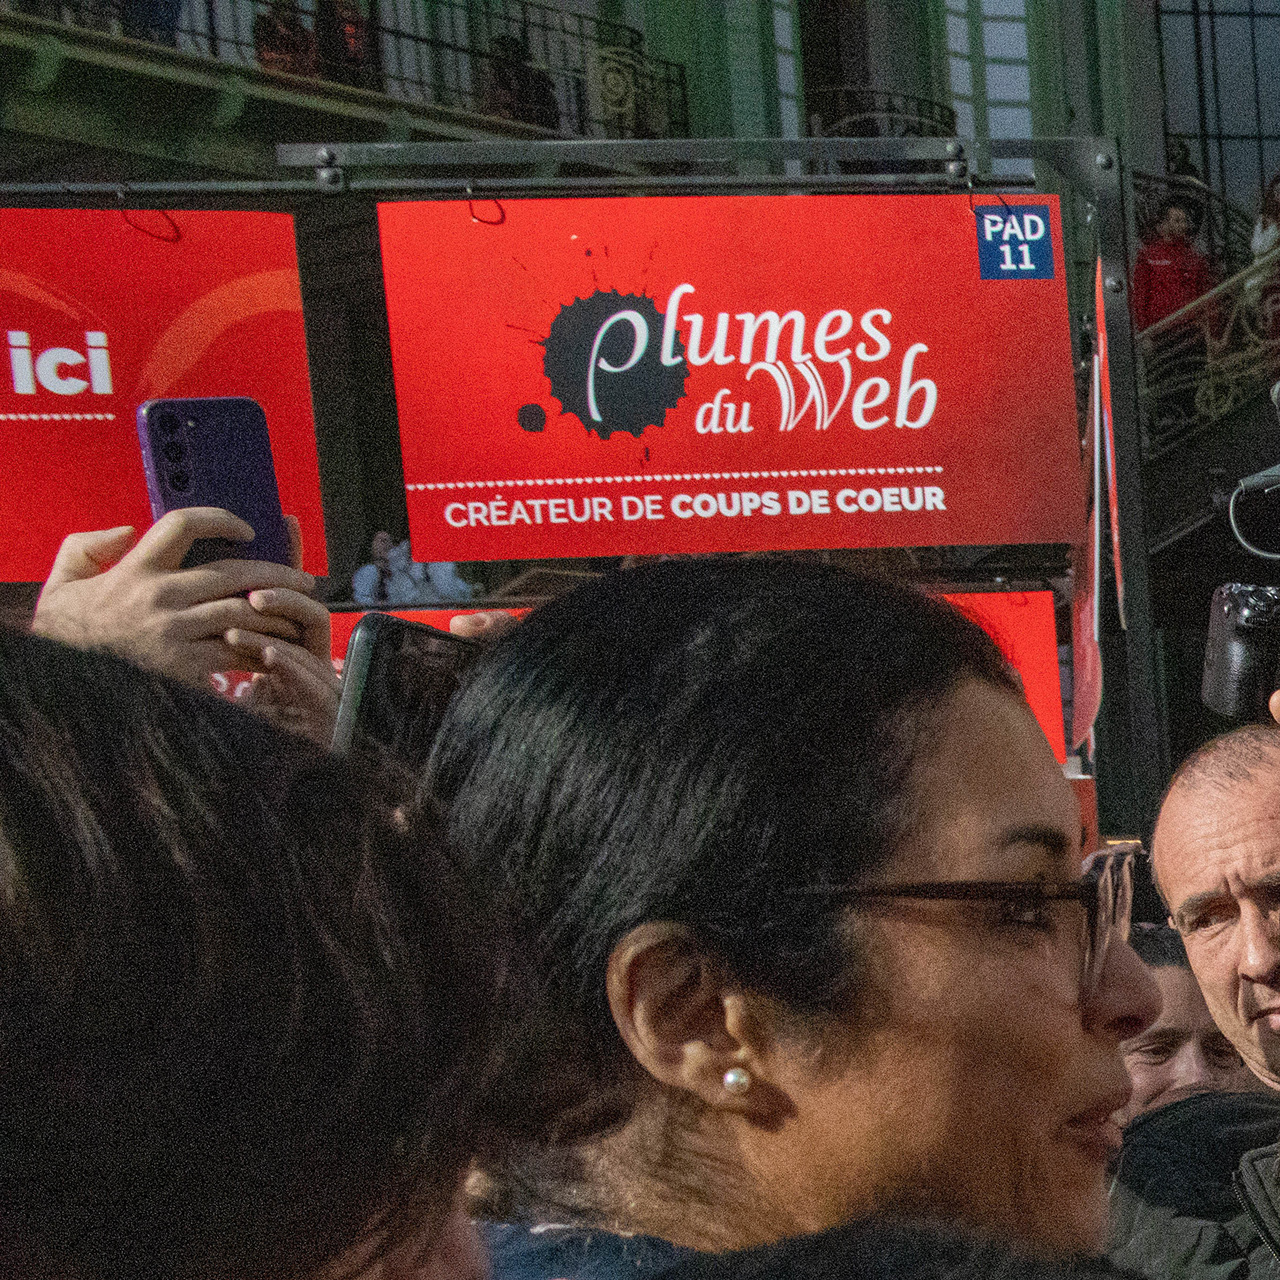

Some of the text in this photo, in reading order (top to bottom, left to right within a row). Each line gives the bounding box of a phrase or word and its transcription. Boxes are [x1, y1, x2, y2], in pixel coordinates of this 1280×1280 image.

[983, 213, 1046, 241] PAD
[1000, 244, 1036, 270] 11
[7, 330, 113, 396] ici
[695, 340, 938, 434] du Web
[444, 486, 947, 527] CRÉATEUR DE COUPS DE COEUR
